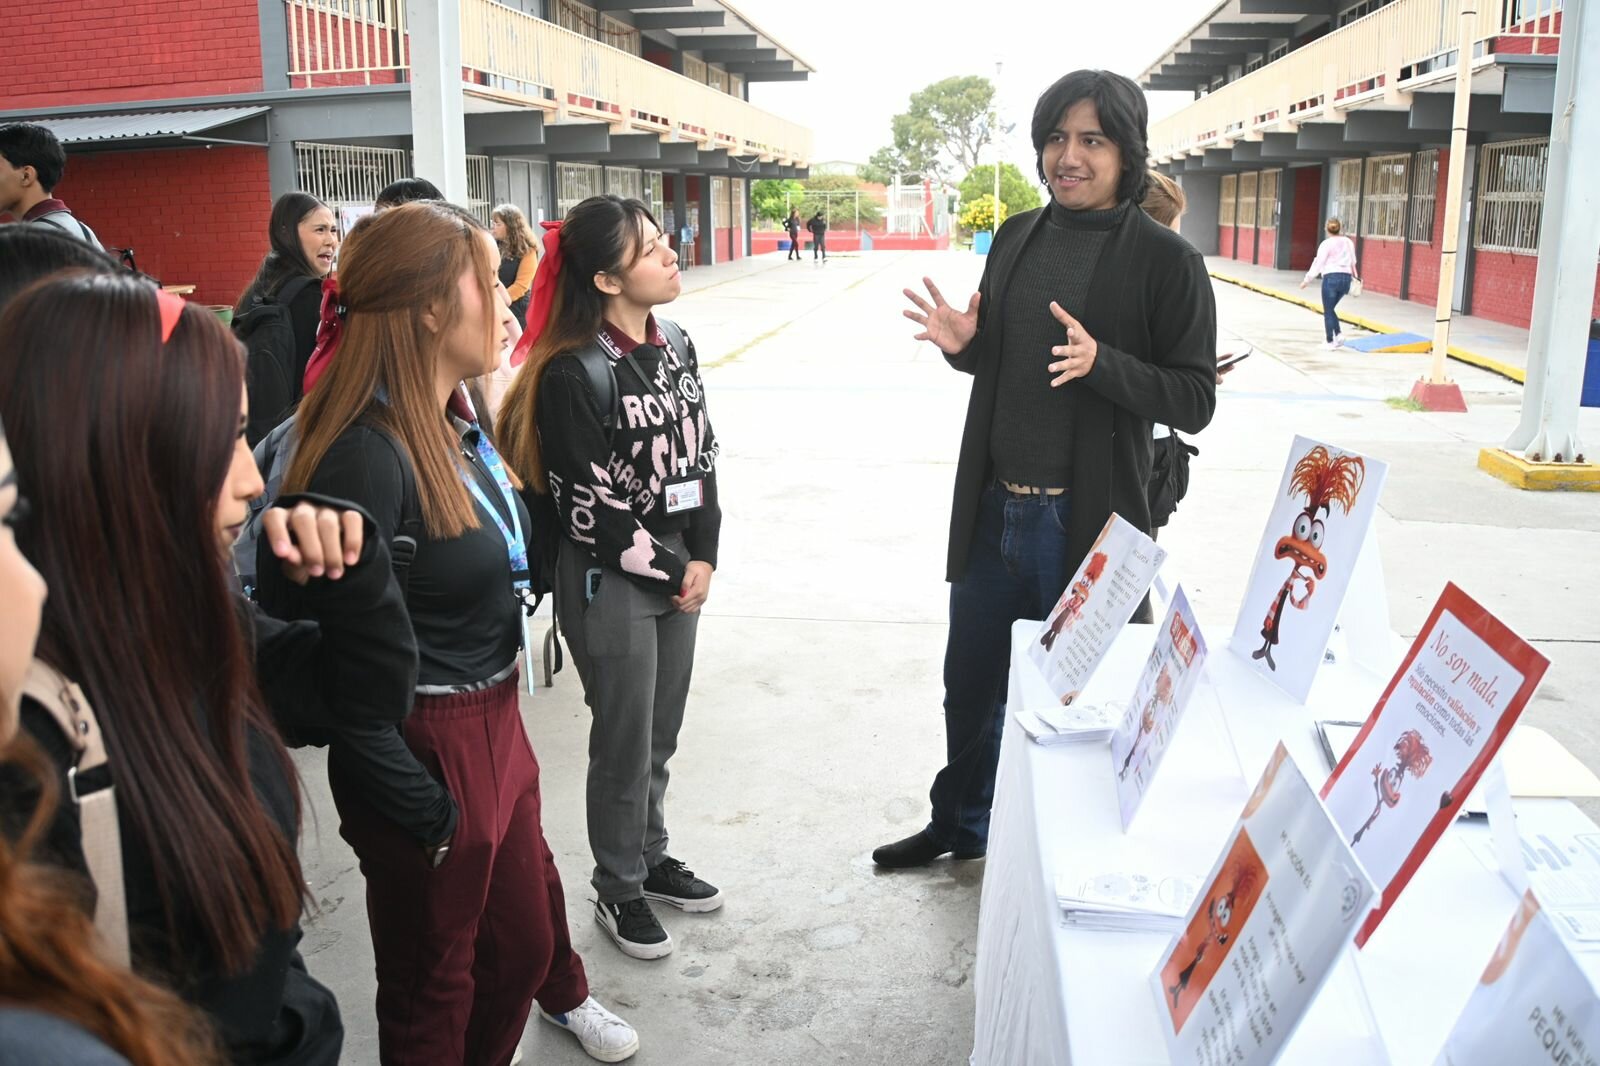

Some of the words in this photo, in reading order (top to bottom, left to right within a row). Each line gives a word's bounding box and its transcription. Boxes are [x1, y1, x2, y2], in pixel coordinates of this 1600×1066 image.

[570, 483, 596, 544] YOU
[1430, 630, 1449, 658] No
[1446, 653, 1471, 685] soy
[1467, 671, 1498, 709] mala.
[1407, 675, 1436, 706] regulación
[1433, 702, 1450, 722] como
[1450, 716, 1465, 739] todas
[1463, 730, 1475, 748] las
[1423, 674, 1448, 701] necesito
[1447, 695, 1477, 731] validación
[1473, 725, 1482, 736] y
[1528, 1006, 1580, 1066] PEQUE
